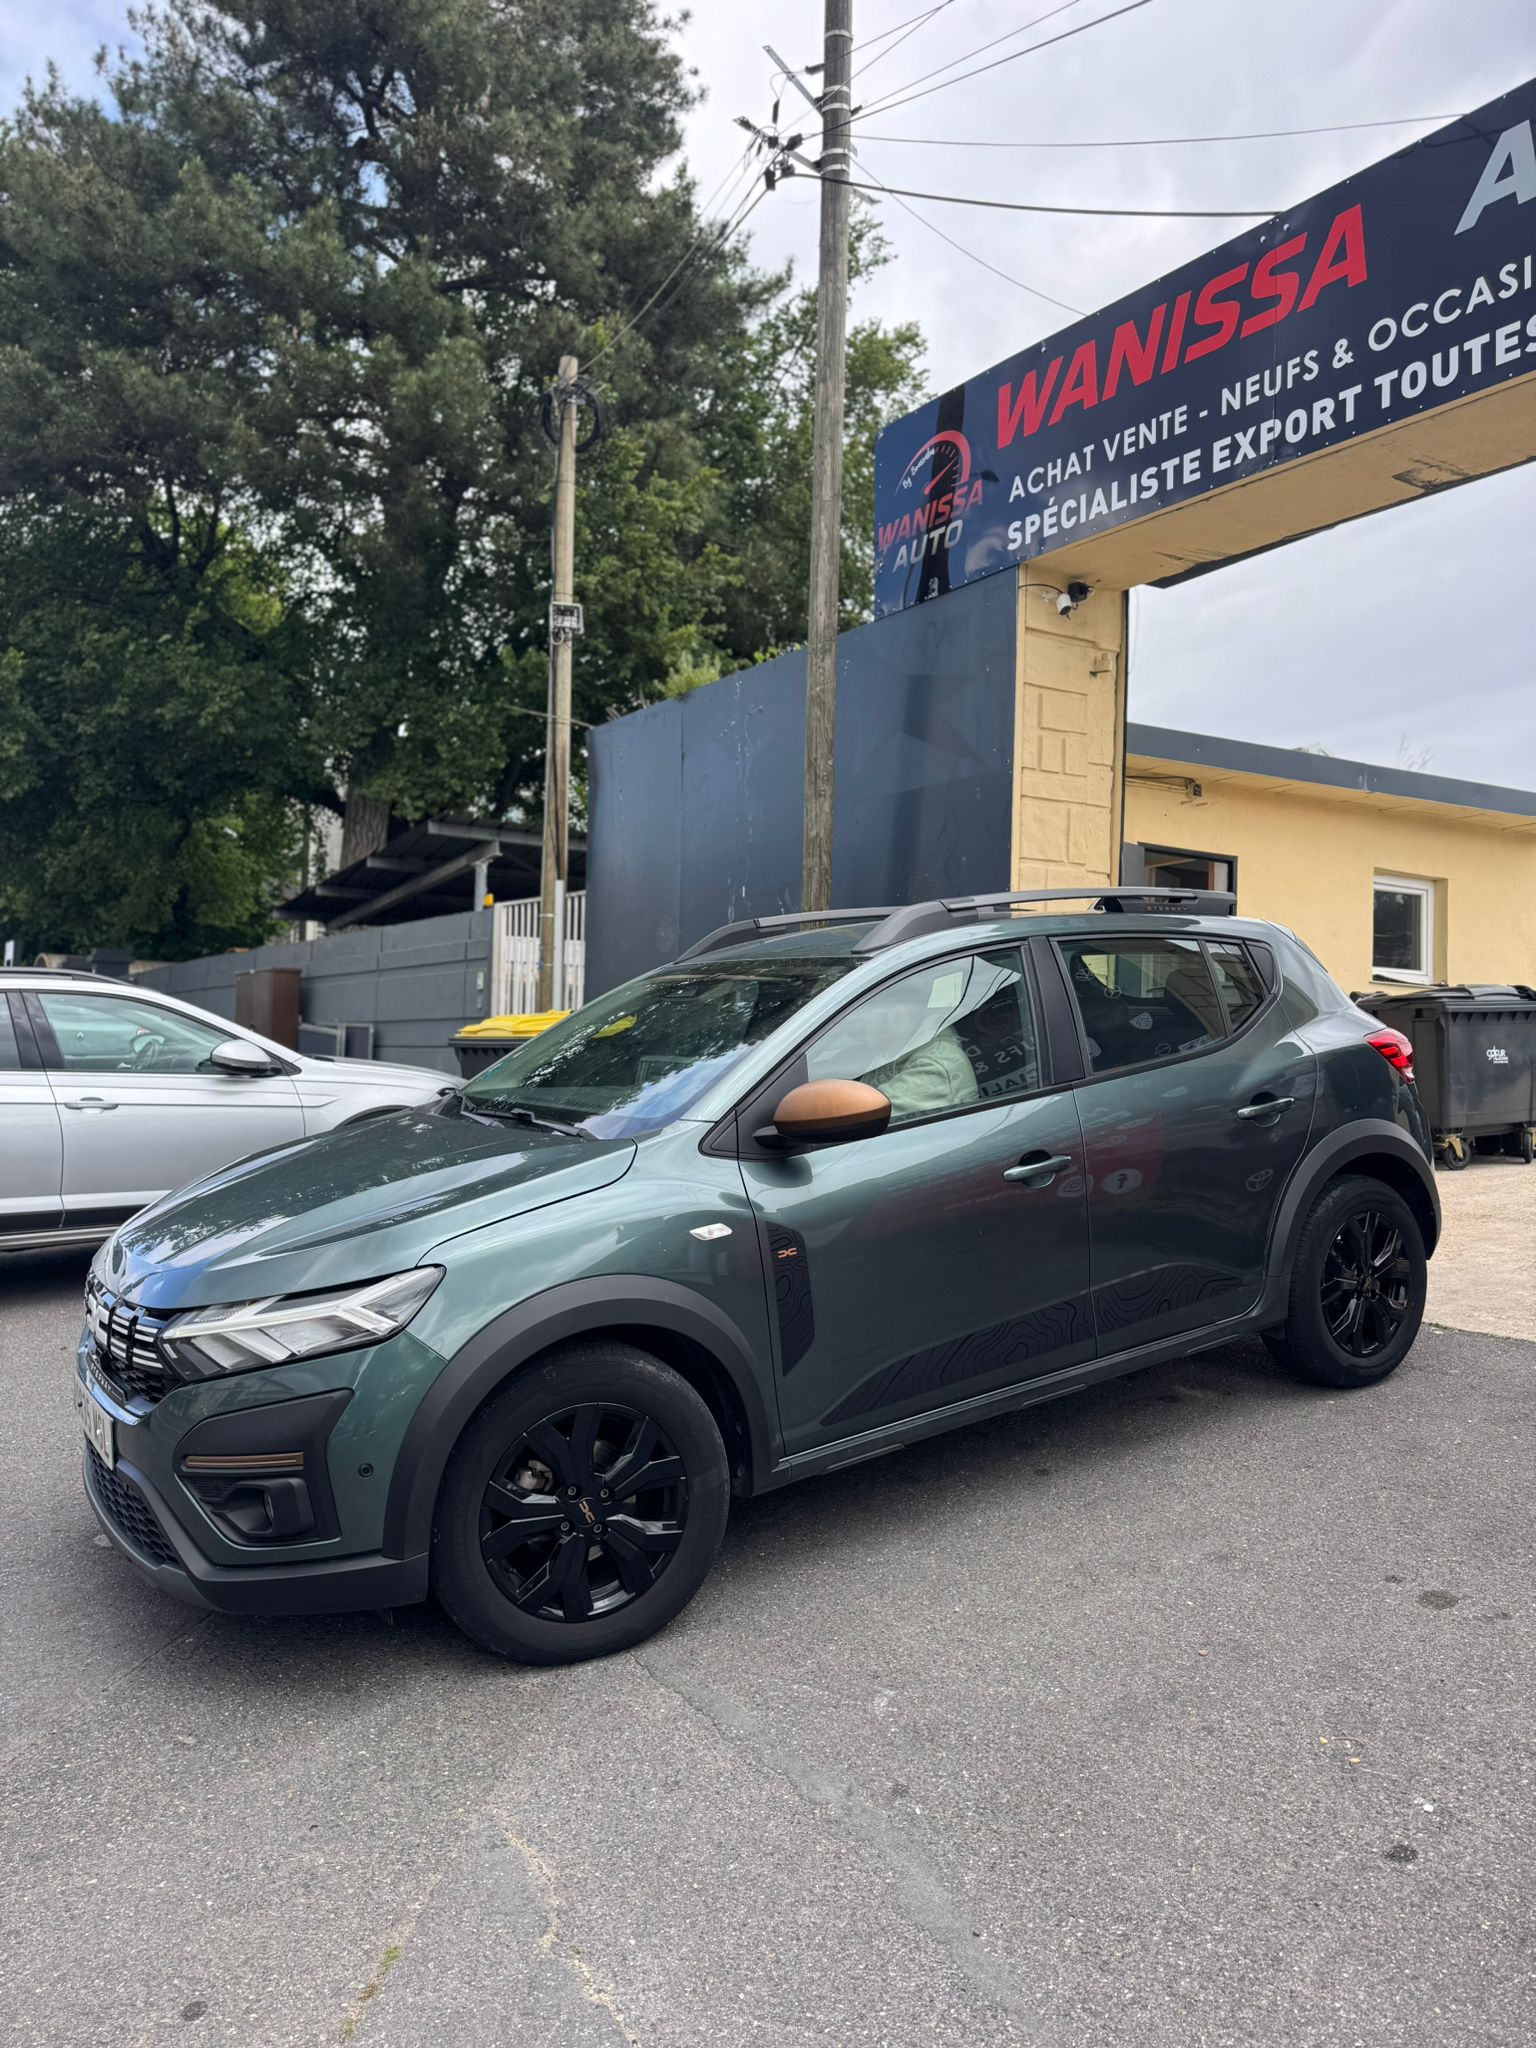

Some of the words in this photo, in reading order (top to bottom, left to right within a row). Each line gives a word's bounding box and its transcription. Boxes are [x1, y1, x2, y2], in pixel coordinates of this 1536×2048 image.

[997, 203, 1368, 449] WANISSA
[1453, 119, 1536, 236] A
[1009, 444, 1095, 503] ACHAT
[1103, 405, 1188, 462] VENTE
[1221, 350, 1319, 416] NEUFS
[1332, 338, 1355, 369] &
[1368, 255, 1532, 351] OCCASI
[878, 479, 984, 552] WANISSA
[892, 519, 964, 573] AUTO
[1007, 448, 1201, 551] SPÉCIALISTE
[1212, 385, 1362, 473] EXPORT
